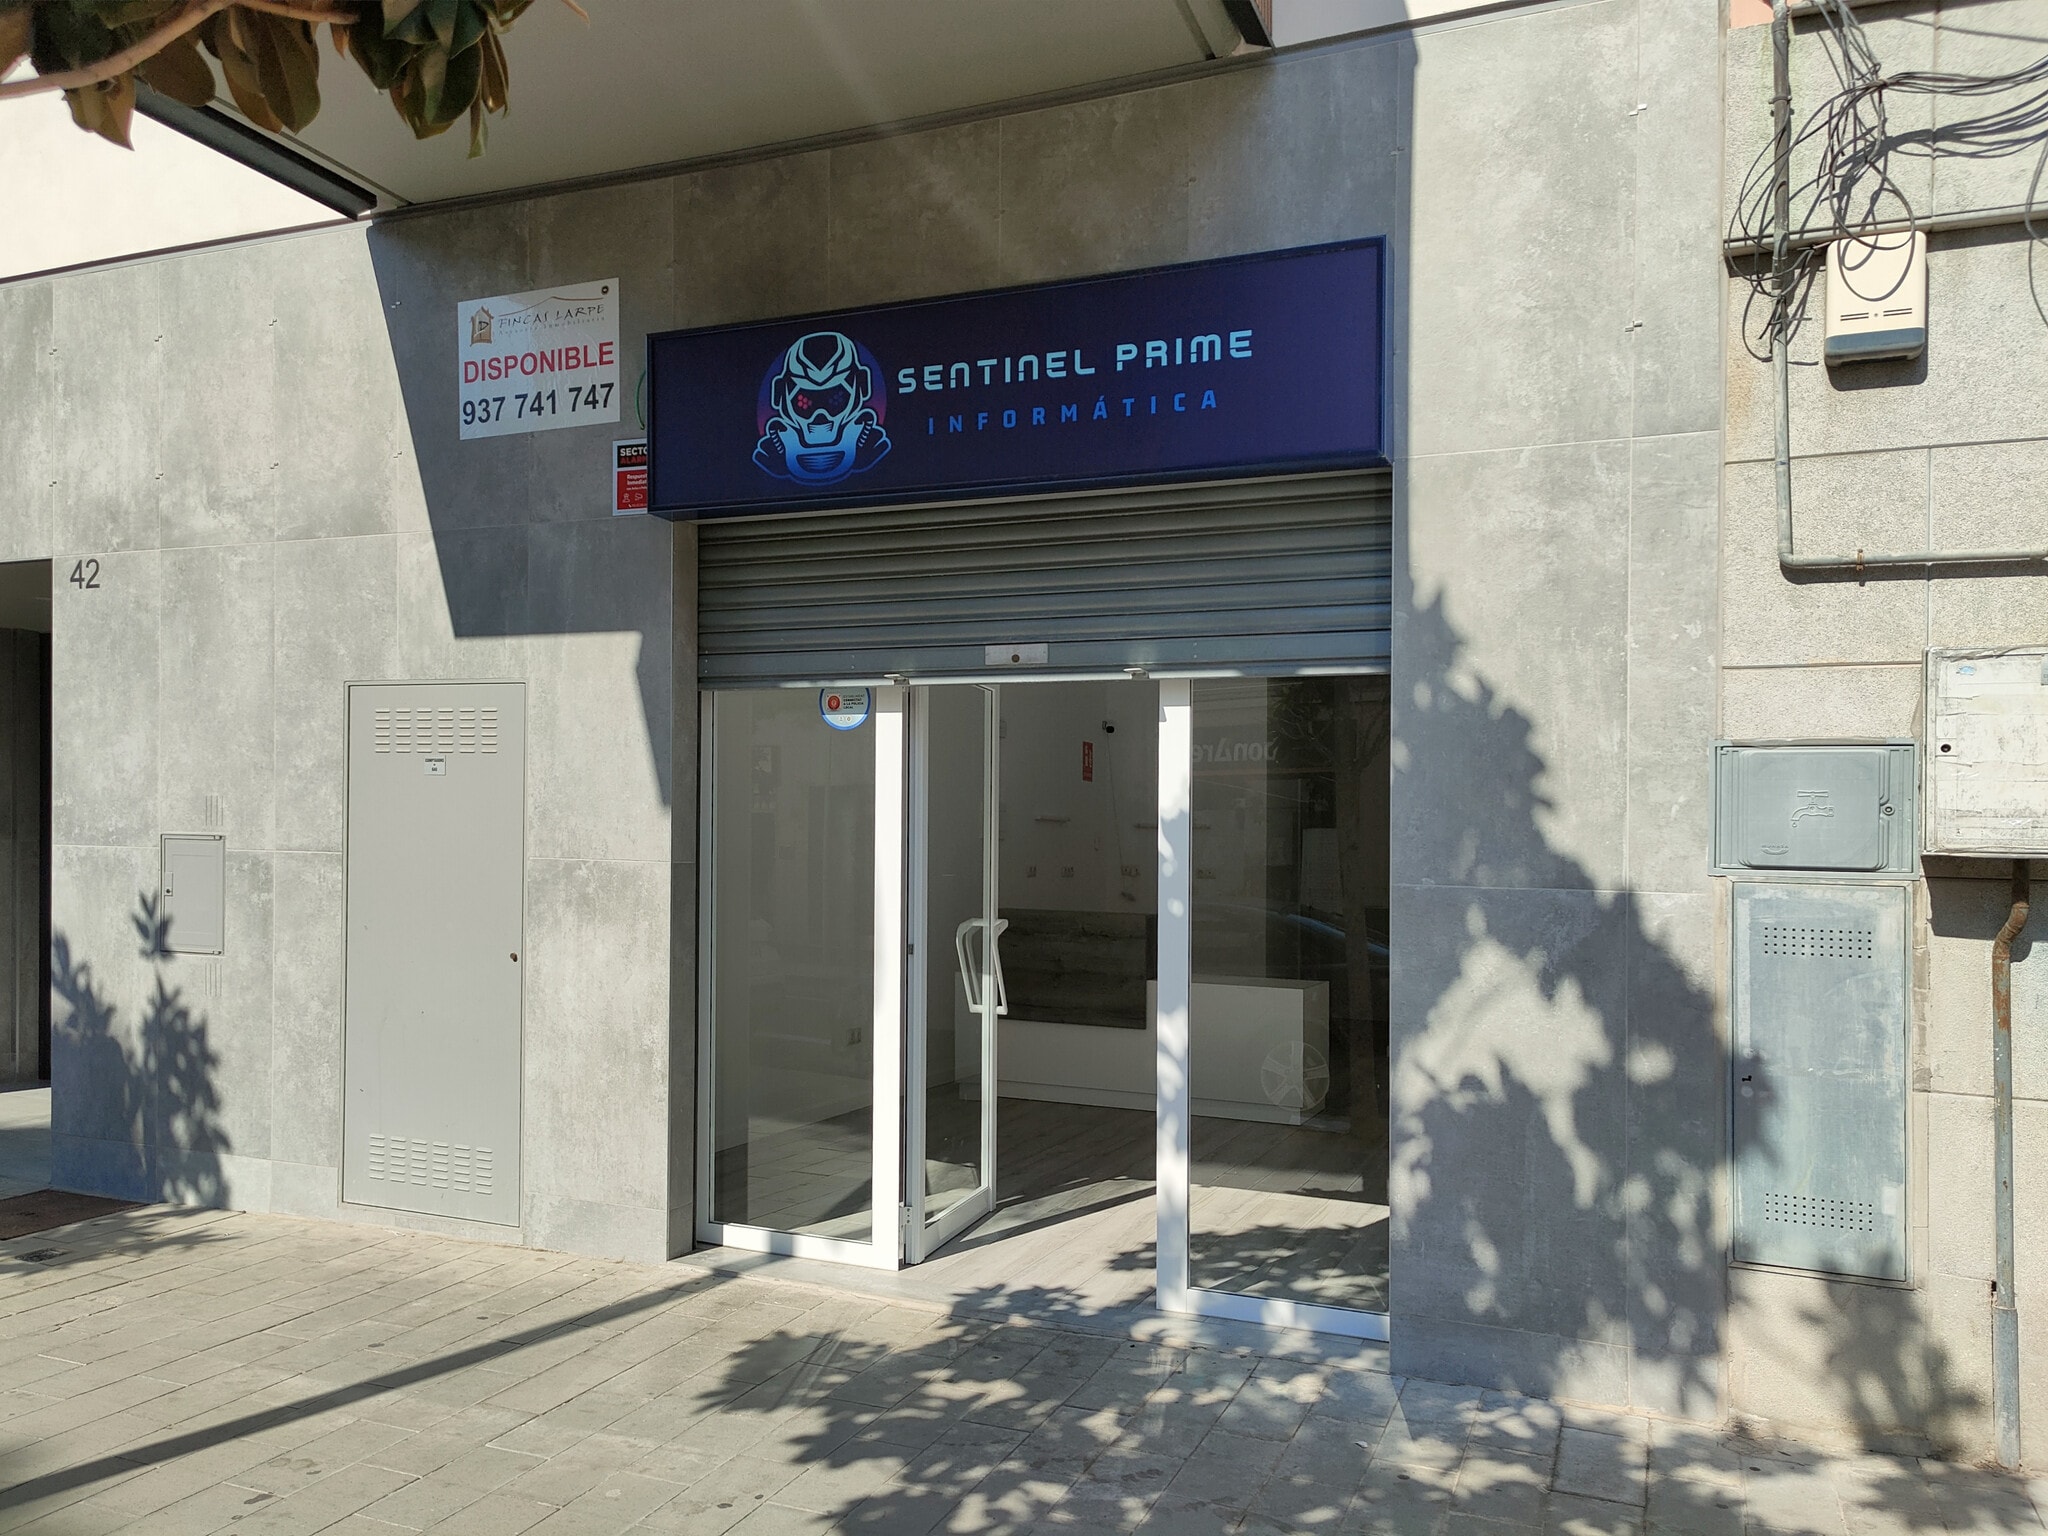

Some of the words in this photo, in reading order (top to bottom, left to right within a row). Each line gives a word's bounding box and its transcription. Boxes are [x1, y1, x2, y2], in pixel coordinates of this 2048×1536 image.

[498, 311, 549, 328] FINCAS
[555, 303, 605, 320] LARPE
[463, 341, 614, 384] DISPONIBLE
[897, 348, 1096, 395] SENTINEL
[1115, 329, 1254, 372] PRIME
[462, 396, 506, 426] 937
[515, 388, 557, 419] 741
[568, 382, 615, 412] 747
[927, 389, 1219, 436] INFORMÁTICA
[69, 558, 101, 590] 42
